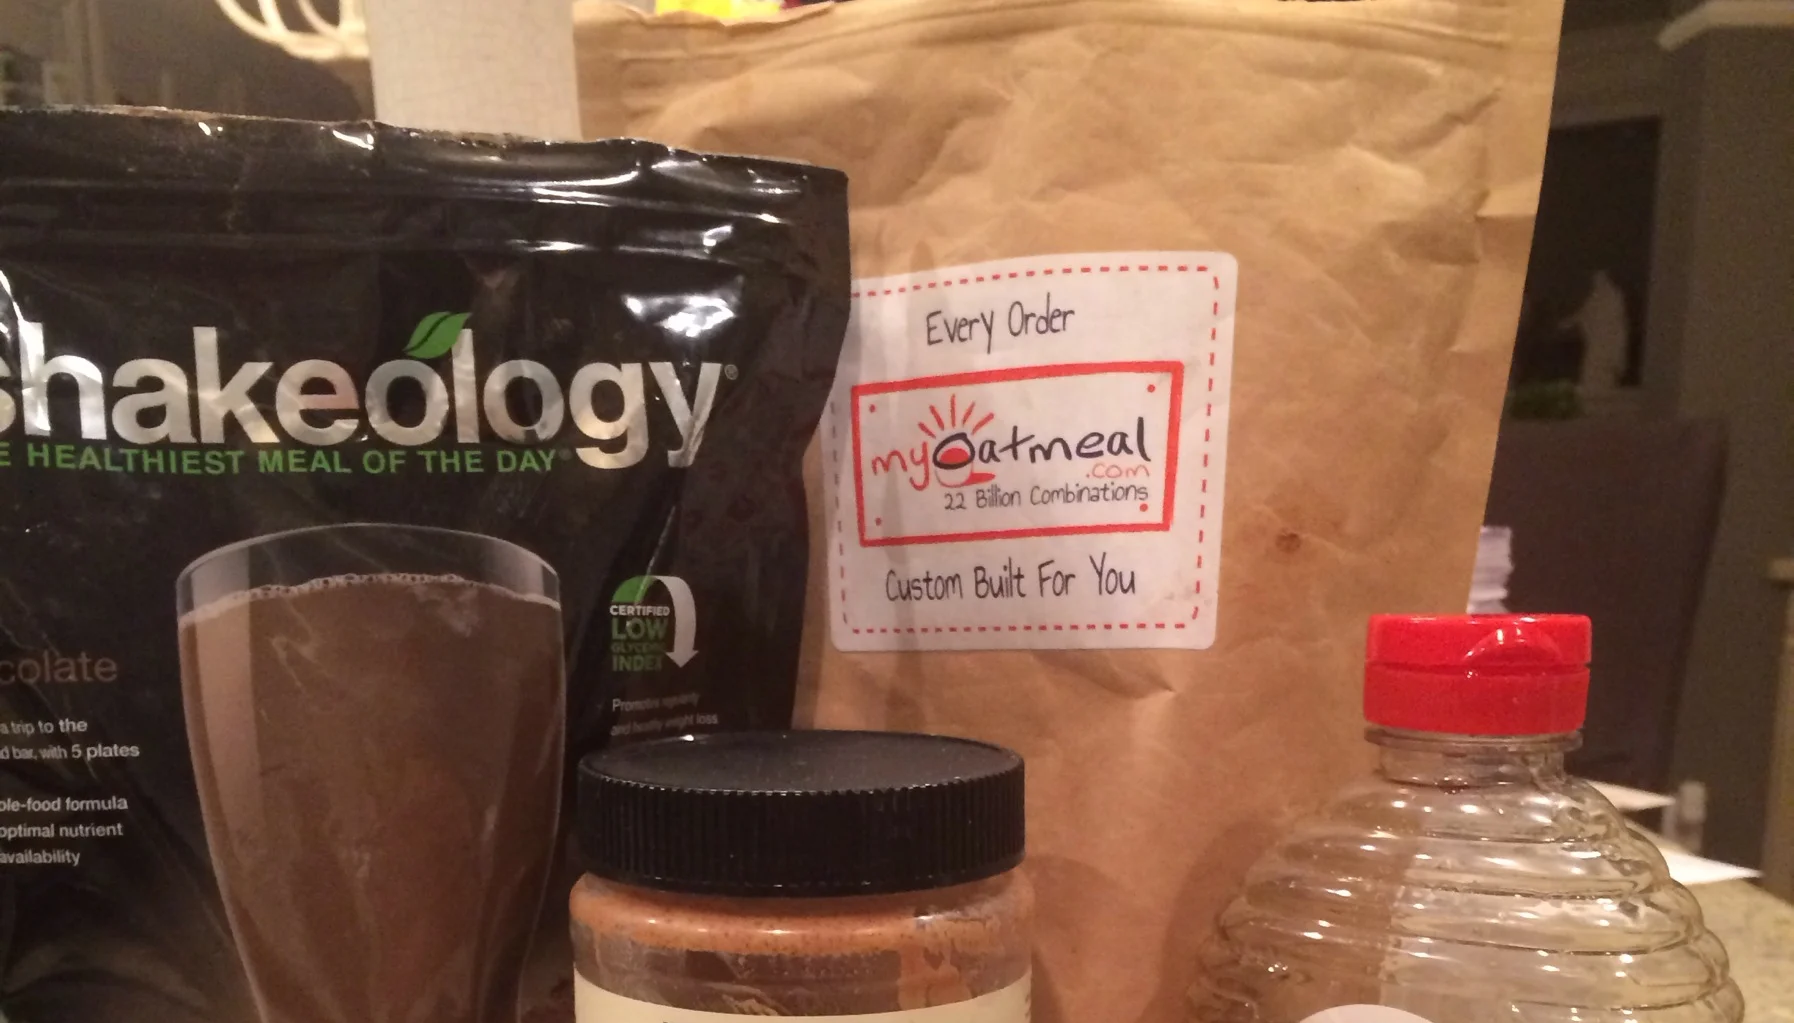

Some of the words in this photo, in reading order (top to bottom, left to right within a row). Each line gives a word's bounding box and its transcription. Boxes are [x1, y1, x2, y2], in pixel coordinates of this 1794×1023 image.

[926, 308, 994, 354] Every
[1008, 293, 1076, 338] Order
[0, 321, 721, 469] hakeology
[27, 442, 244, 474] HEALTHIEST
[258, 449, 353, 473] MEAL
[362, 450, 406, 474] OF
[416, 450, 485, 473] THE
[496, 449, 556, 472] DAY
[1084, 462, 1150, 479] .com
[943, 492, 967, 511] 22
[976, 484, 1022, 509] Billion
[1030, 482, 1149, 506] Combinations
[885, 569, 964, 601] Custom
[974, 557, 1026, 598] Built
[1038, 559, 1077, 598] For
[1089, 551, 1136, 595] You
[610, 605, 670, 617] CERTIFIED
[611, 617, 669, 641] LOW
[11, 720, 35, 738] trip
[38, 720, 54, 734] to
[59, 718, 88, 733] the
[696, 713, 718, 725] loss
[39, 745, 67, 760] with
[72, 744, 82, 759] 5
[86, 744, 140, 761] plates
[66, 796, 128, 812] formula
[59, 823, 123, 837] nutrient
